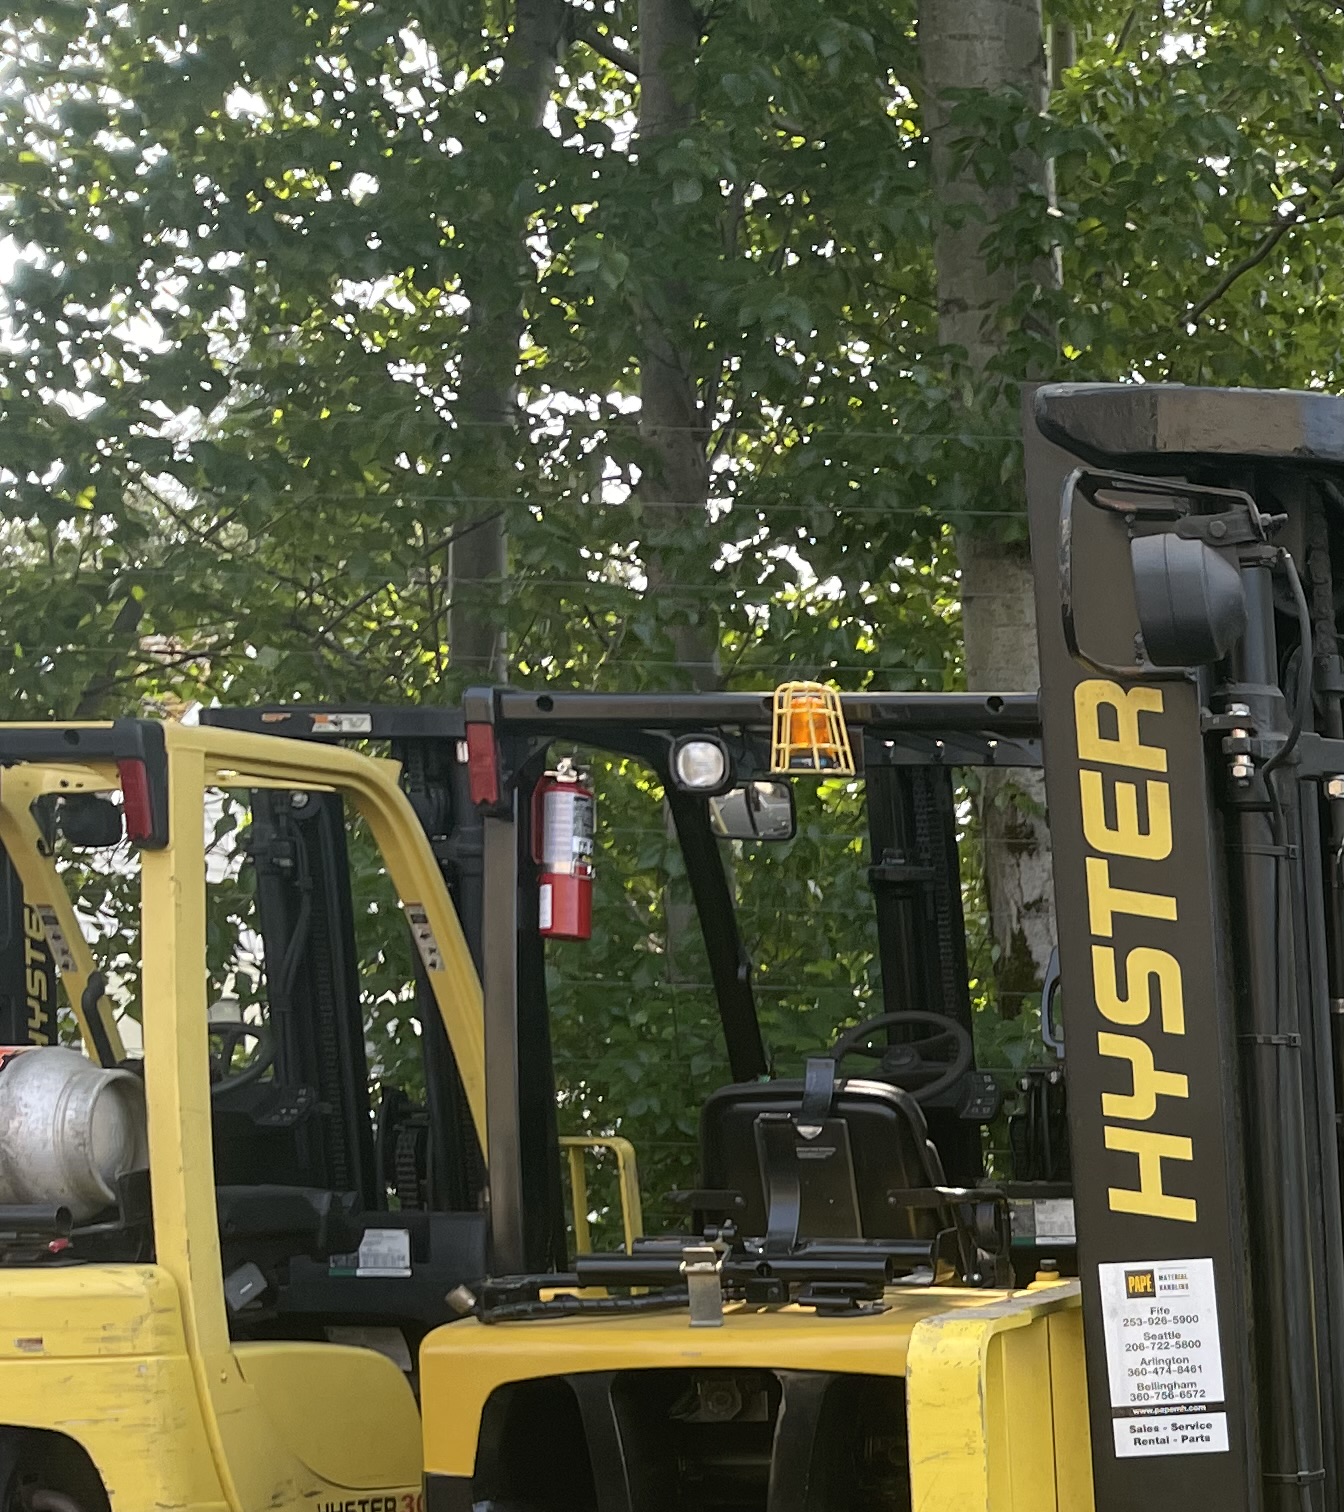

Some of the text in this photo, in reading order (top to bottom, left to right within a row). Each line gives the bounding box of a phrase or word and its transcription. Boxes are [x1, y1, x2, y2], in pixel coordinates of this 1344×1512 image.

[1073, 679, 1197, 1223] HYSTER
[24, 904, 49, 1046] HYSTE
[1149, 1306, 1170, 1316] Fife
[1143, 1331, 1182, 1342] Seattle
[1139, 1356, 1190, 1367] Arlington
[1136, 1381, 1198, 1392] Bellingham
[1129, 1424, 1160, 1434] Sales
[1170, 1421, 1213, 1432] Service
[1133, 1436, 1170, 1446] Rental
[1181, 1434, 1211, 1444] Parts
